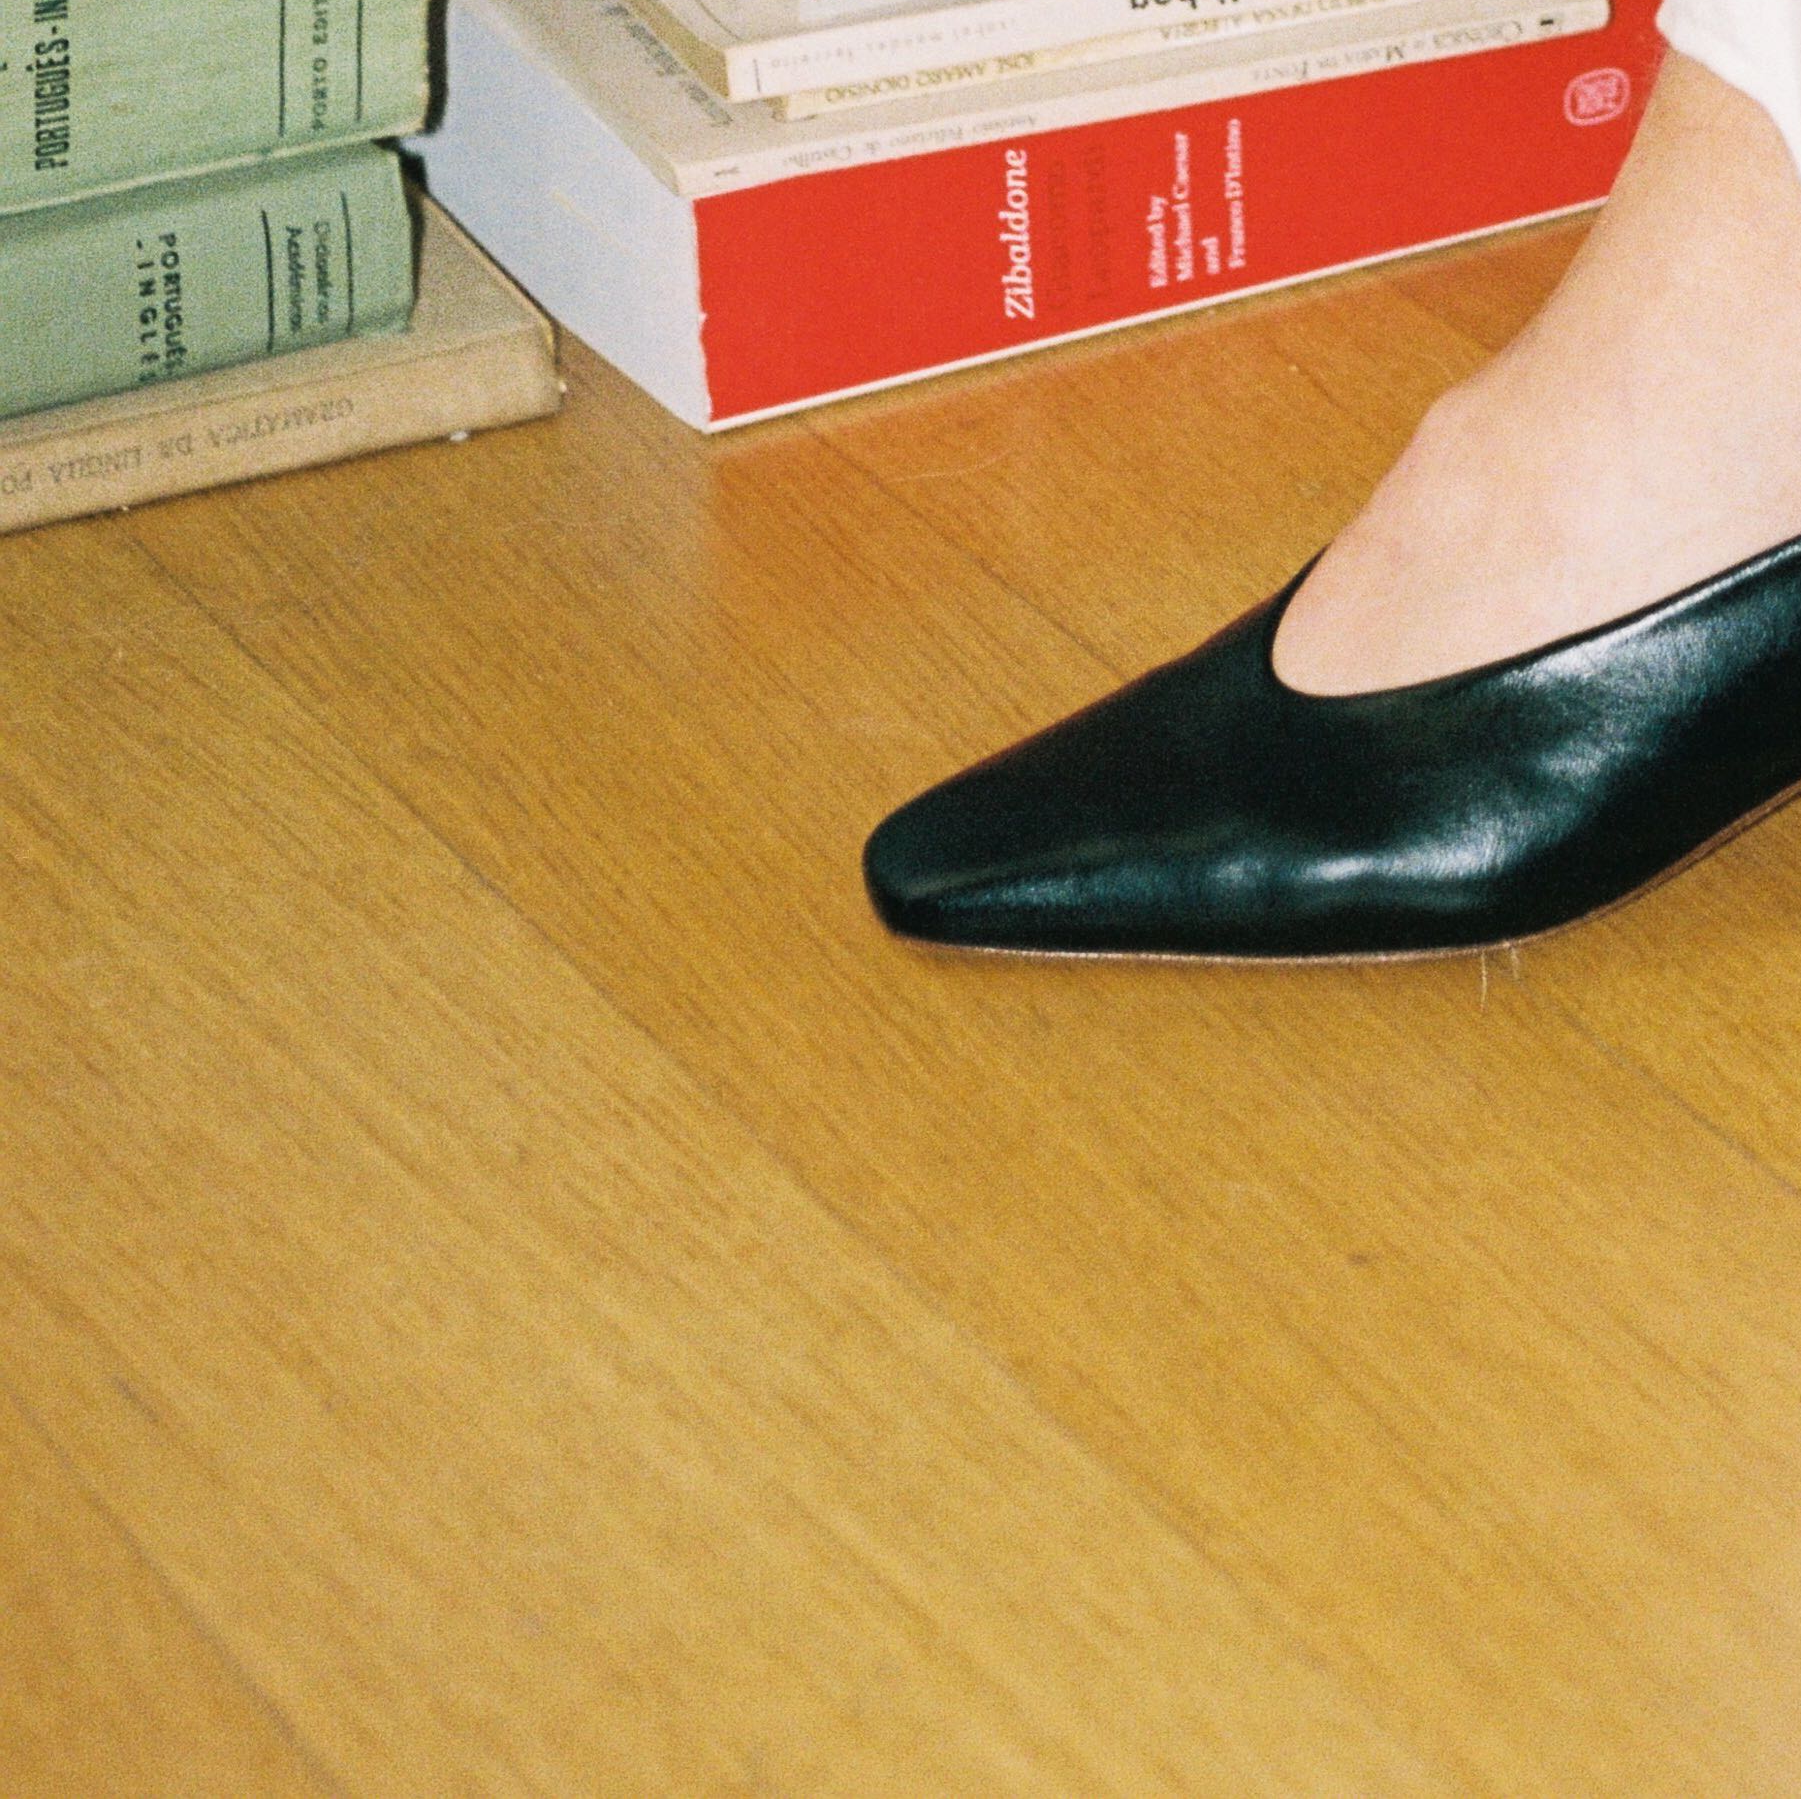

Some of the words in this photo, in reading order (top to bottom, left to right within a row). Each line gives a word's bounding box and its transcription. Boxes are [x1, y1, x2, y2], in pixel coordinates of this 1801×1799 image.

[311, 57, 331, 132] PORTO
[914, 59, 987, 88] AMARO
[1171, 131, 1191, 200] Caesar
[997, 147, 1035, 321] Zibaldone
[1146, 193, 1169, 222] by
[1170, 201, 1195, 283] Michael
[1227, 199, 1246, 270] Franco
[1146, 223, 1170, 289] Edited
[1199, 234, 1221, 276] and
